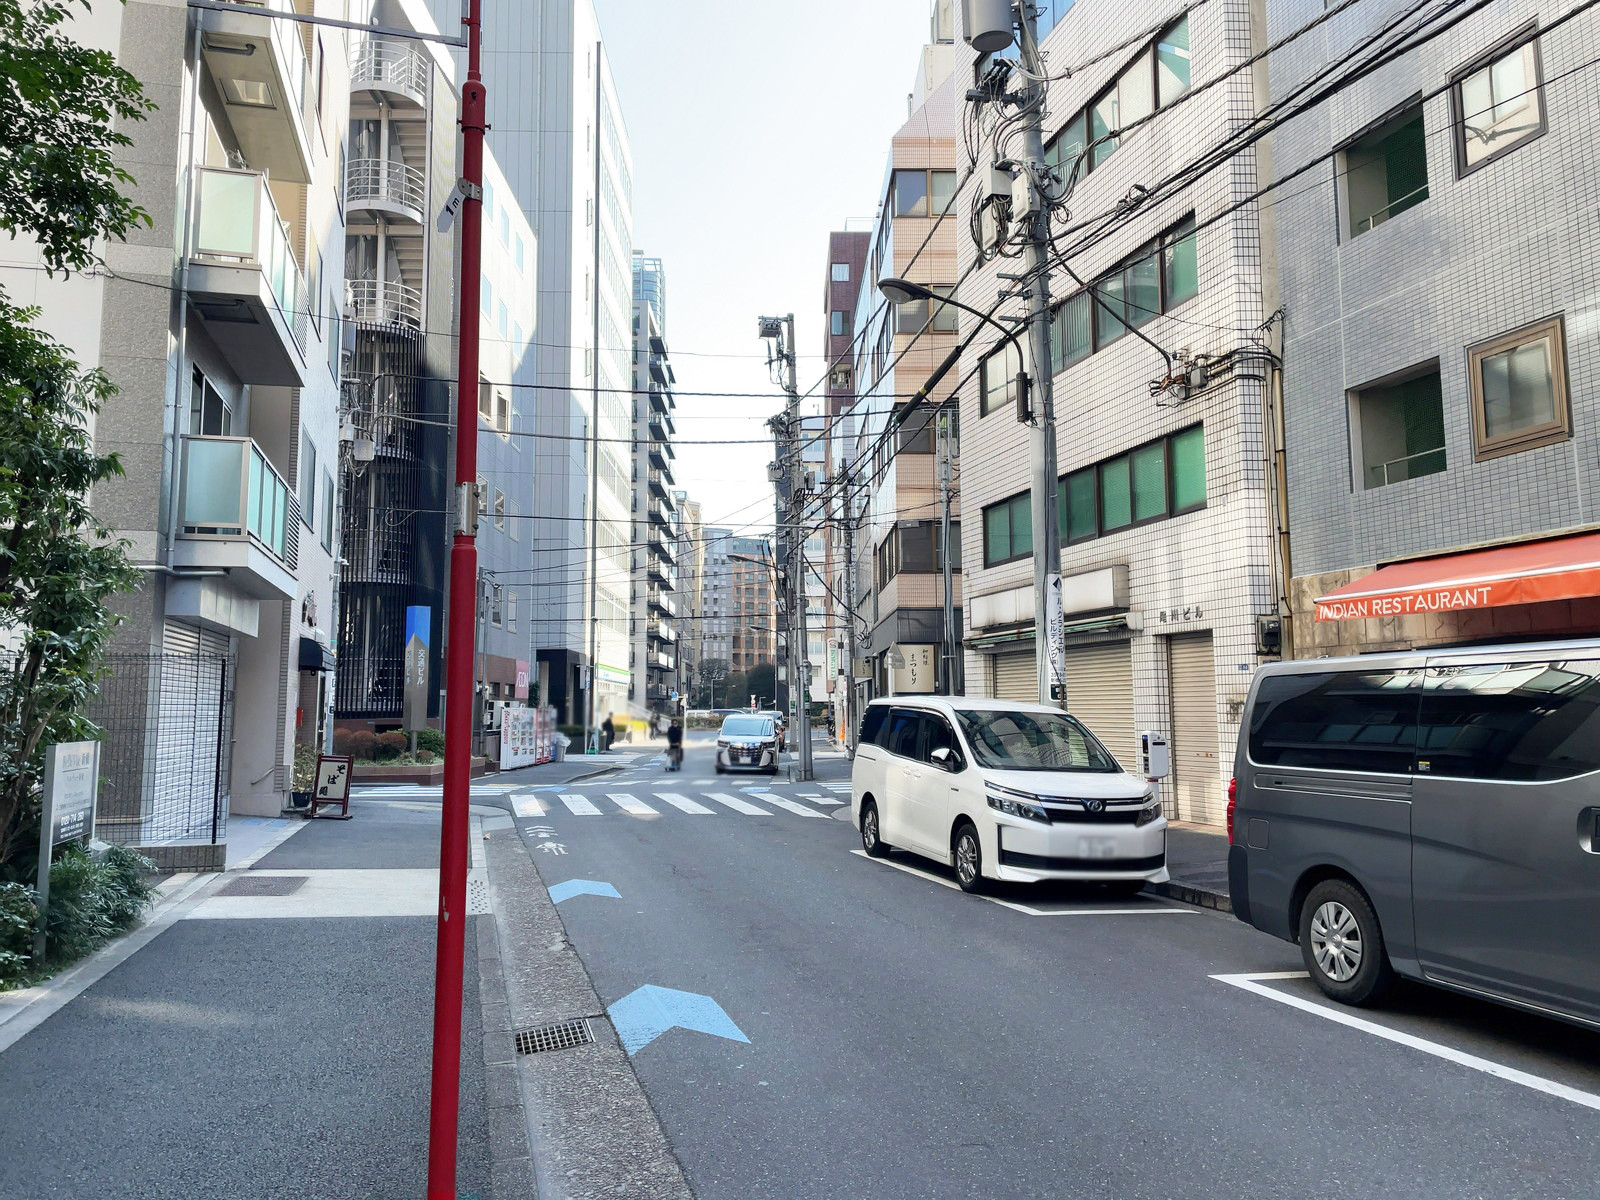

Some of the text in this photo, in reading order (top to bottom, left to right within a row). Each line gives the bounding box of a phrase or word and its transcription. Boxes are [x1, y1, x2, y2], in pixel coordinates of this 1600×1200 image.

[1319, 586, 1492, 620] INDIAN RESTAURANT
[416, 648, 426, 687] 交通ビル
